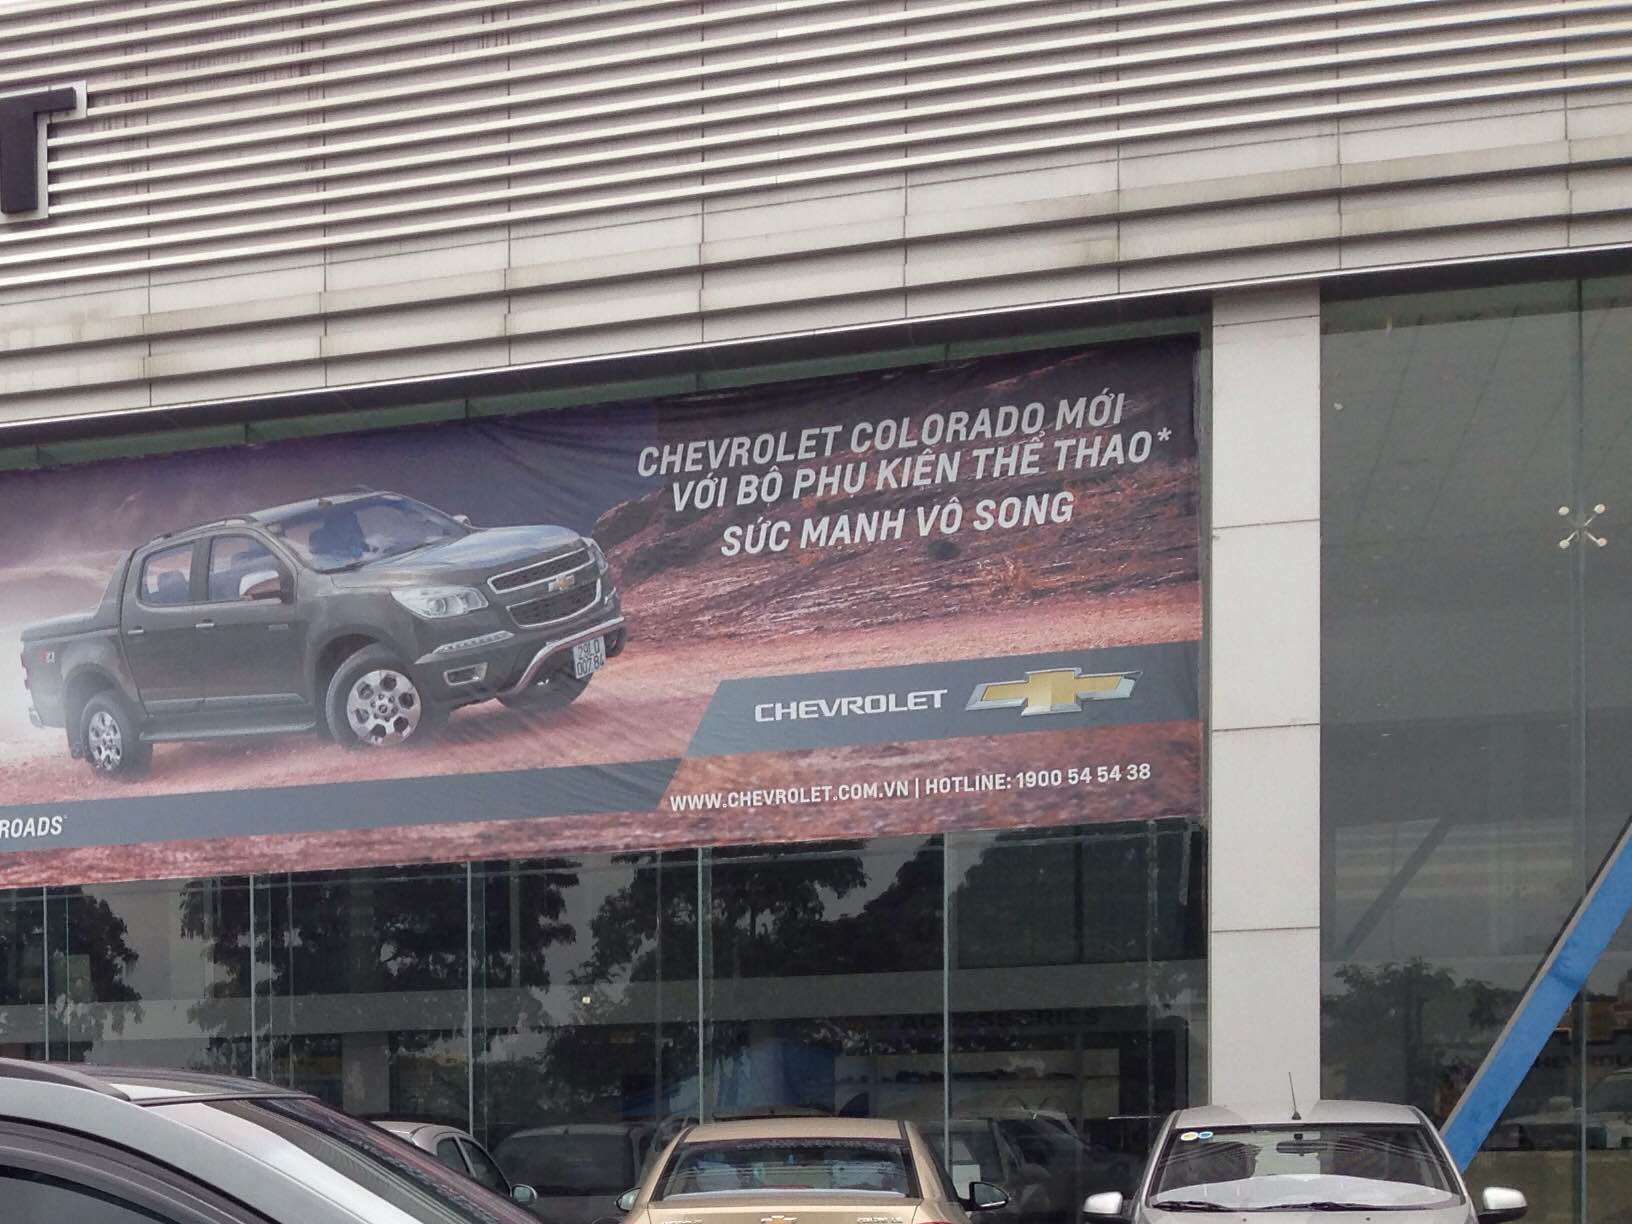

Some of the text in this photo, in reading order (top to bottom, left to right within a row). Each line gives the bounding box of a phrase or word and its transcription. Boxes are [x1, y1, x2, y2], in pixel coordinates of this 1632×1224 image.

[638, 388, 1125, 477] CHEVROLET COLORADO MỚI
[672, 472, 728, 511] VỚI
[792, 462, 867, 498] PHỤ
[971, 430, 1046, 479] THỂ
[721, 491, 1074, 556] SỨC MẠNH VÔ SONG
[755, 689, 948, 722] CHEVROLET
[670, 763, 1151, 812] WWW.CHEVROLET.COM.VN HOTLINE: 1900 54 54 38
